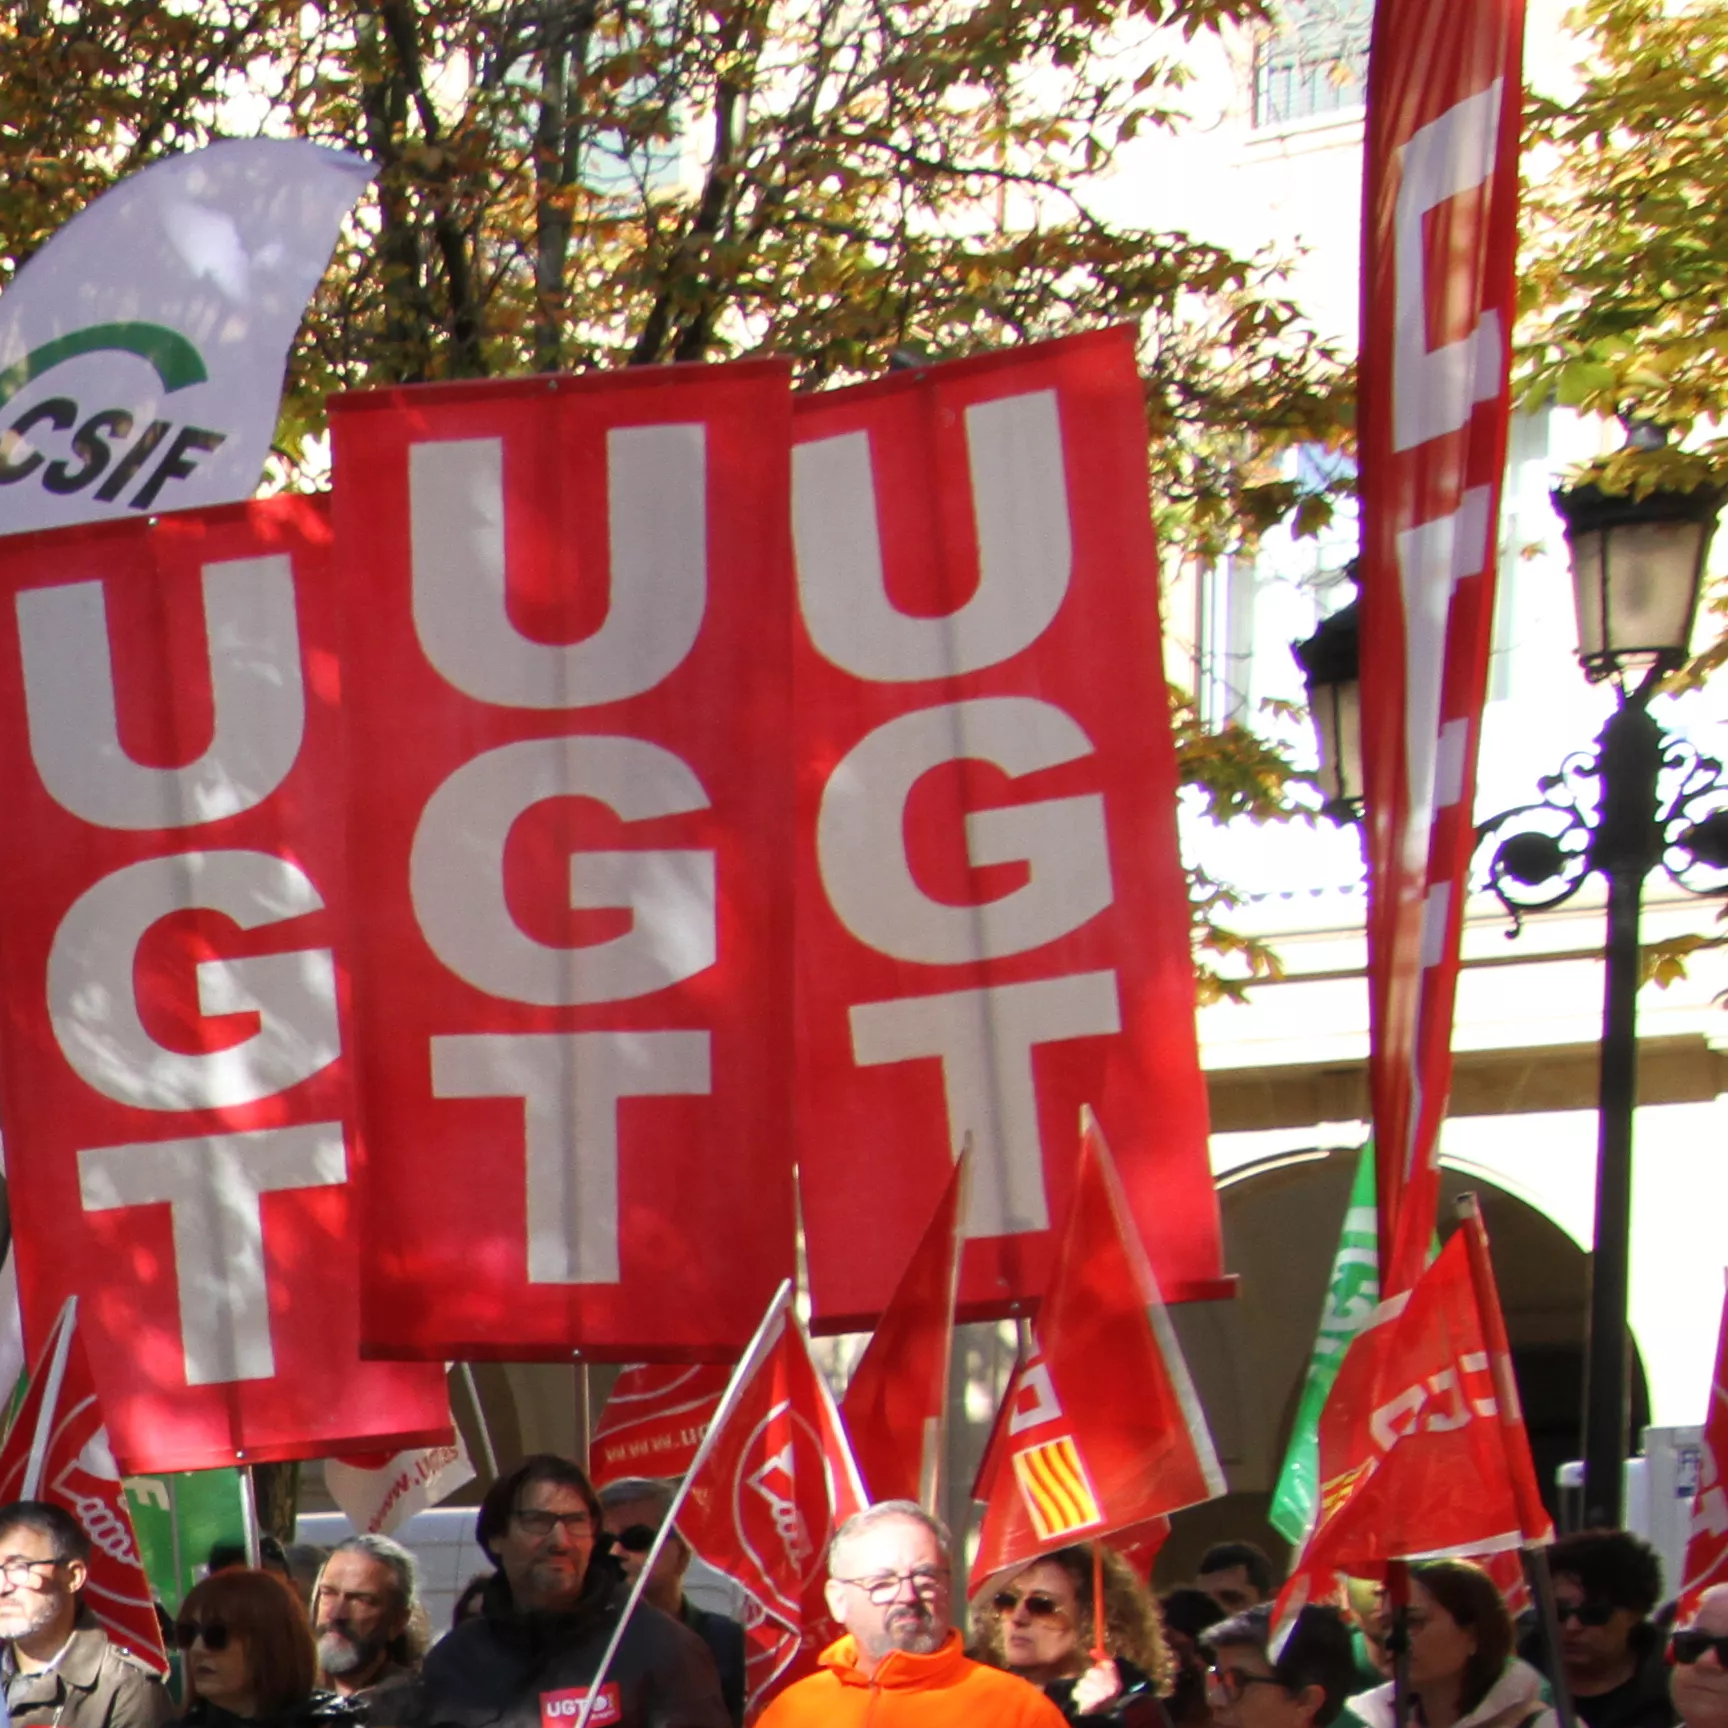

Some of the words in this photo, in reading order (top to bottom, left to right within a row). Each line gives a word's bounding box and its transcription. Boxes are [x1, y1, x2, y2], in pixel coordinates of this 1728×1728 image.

[14, 553, 347, 1386] UGT
[409, 422, 717, 1285] UGT
[791, 389, 1122, 1240] UGT
[547, 1697, 593, 1717] UGT
